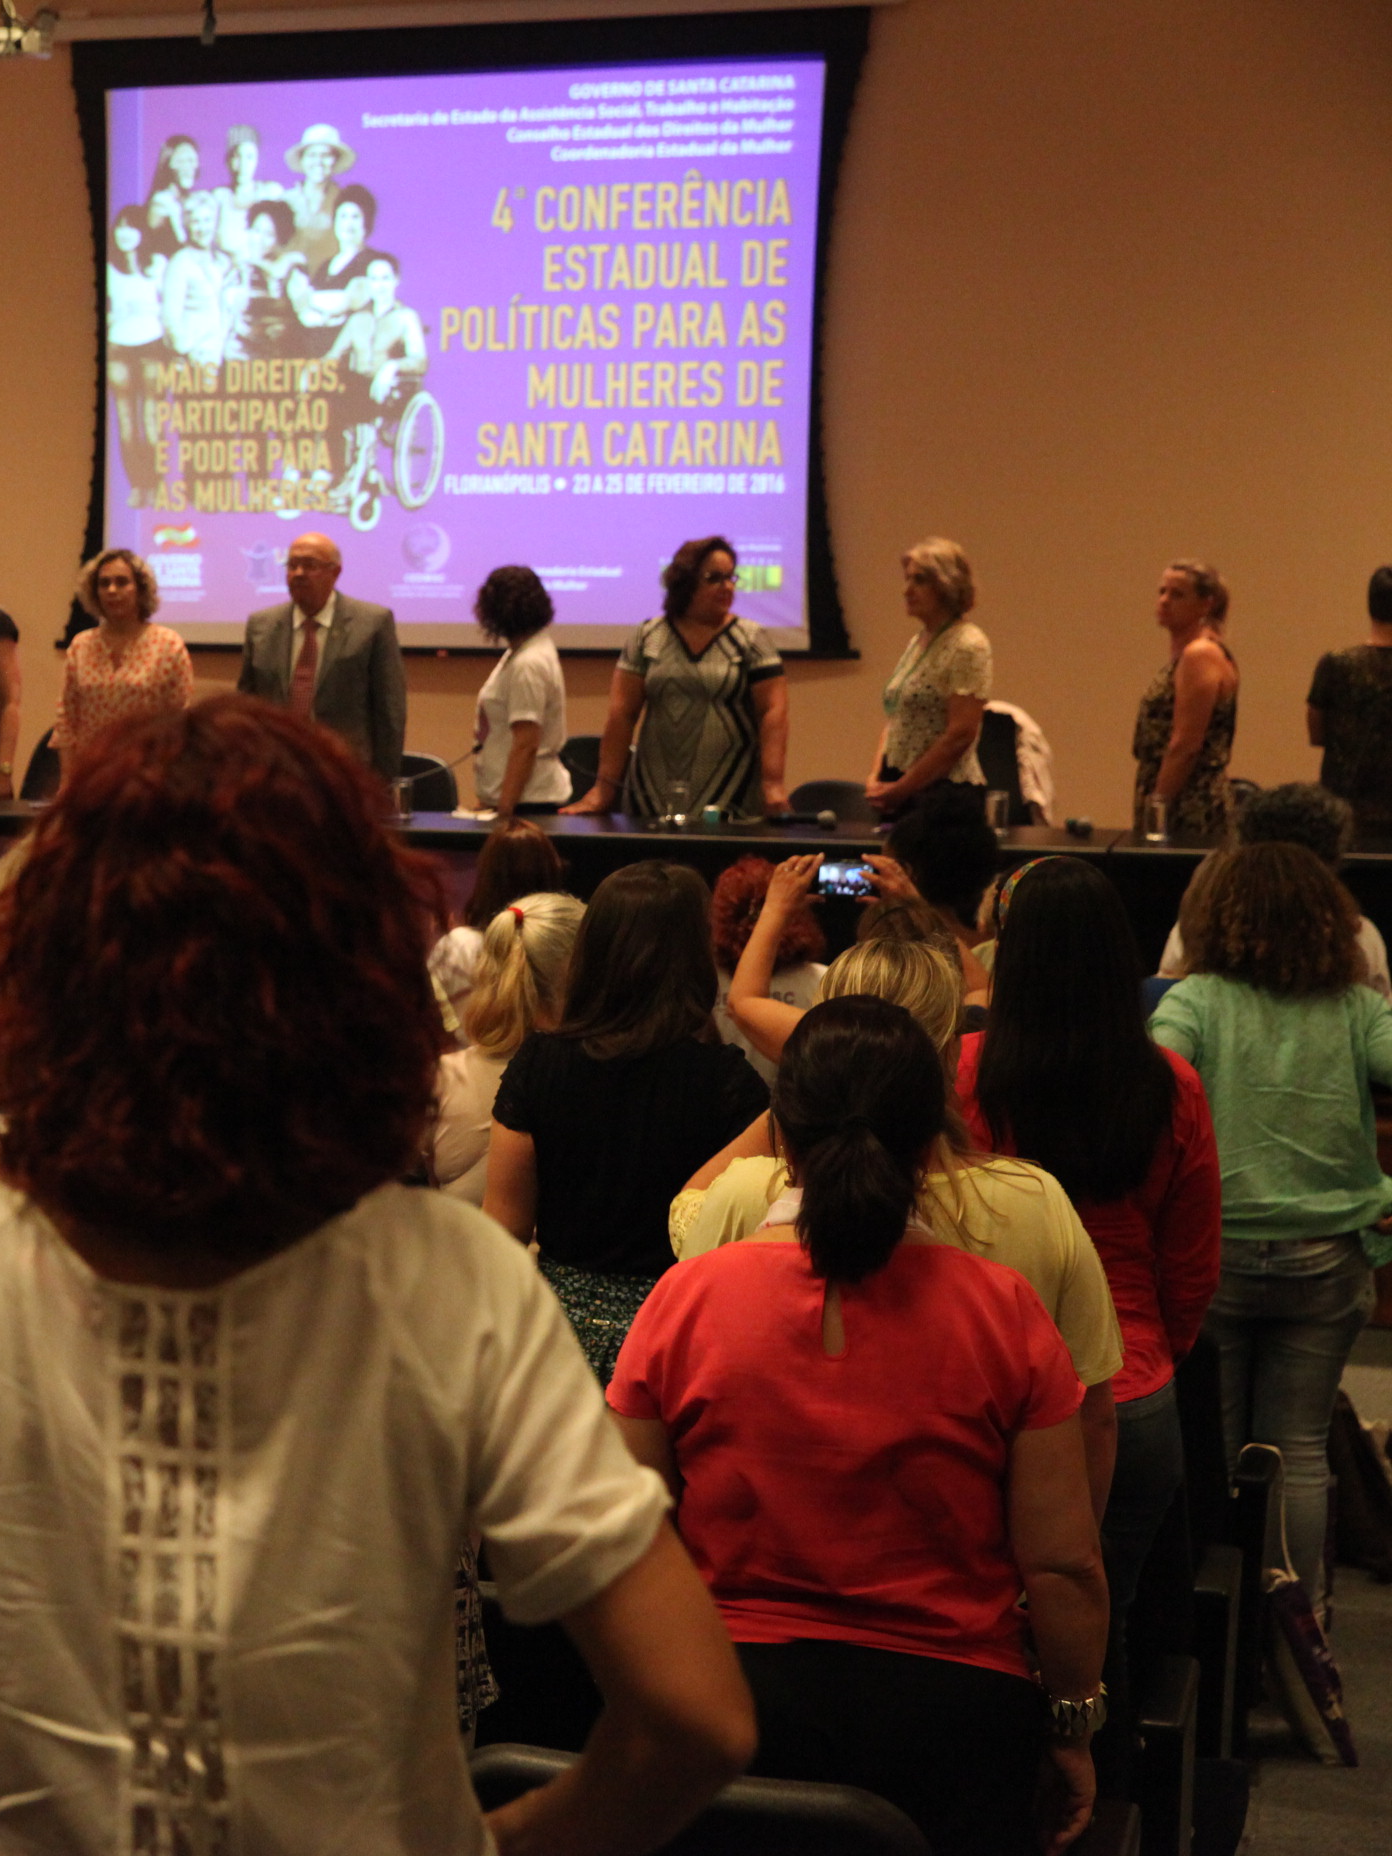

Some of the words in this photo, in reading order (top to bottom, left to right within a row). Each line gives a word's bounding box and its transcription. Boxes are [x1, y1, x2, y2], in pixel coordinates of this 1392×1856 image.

[569, 80, 642, 100] GOVERNO
[644, 79, 665, 97] DE
[667, 77, 717, 96] SANTA
[719, 74, 796, 94] CATARINA
[361, 110, 429, 129] Secretaria
[450, 107, 497, 125] Estado
[645, 99, 707, 117] Trabalho
[708, 101, 719, 115] e
[506, 124, 571, 144] Conselho
[572, 122, 633, 141] Estadual
[661, 119, 718, 138] Direitos
[740, 117, 794, 135] Mulher
[656, 140, 718, 159] Estadual
[740, 137, 794, 155] Mulher
[535, 168, 793, 232] CONFERÊNCIA
[543, 241, 728, 292] ESTADUAL
[740, 239, 789, 288] DE
[440, 293, 621, 352] POLÍTICAS
[632, 301, 728, 350] PARA
[737, 299, 788, 348] AS
[156, 360, 219, 393] MAIS
[527, 359, 725, 409] MULHERES
[737, 359, 785, 408] DE
[156, 394, 329, 440] PARTICIPAÇÃO
[155, 440, 170, 474] E
[178, 439, 258, 473] PODER
[266, 438, 332, 472] PARA
[476, 421, 593, 468] SANTA
[603, 419, 783, 467] CATARINA
[154, 480, 187, 513] AS
[444, 470, 550, 495] FLORIANÓPOLIS
[572, 473, 591, 495] 23
[592, 473, 603, 495] A
[605, 473, 623, 495] 25
[625, 473, 645, 495] DE
[647, 472, 725, 495] FEVEREIRO
[727, 472, 748, 495] DE
[750, 472, 786, 494] 2016
